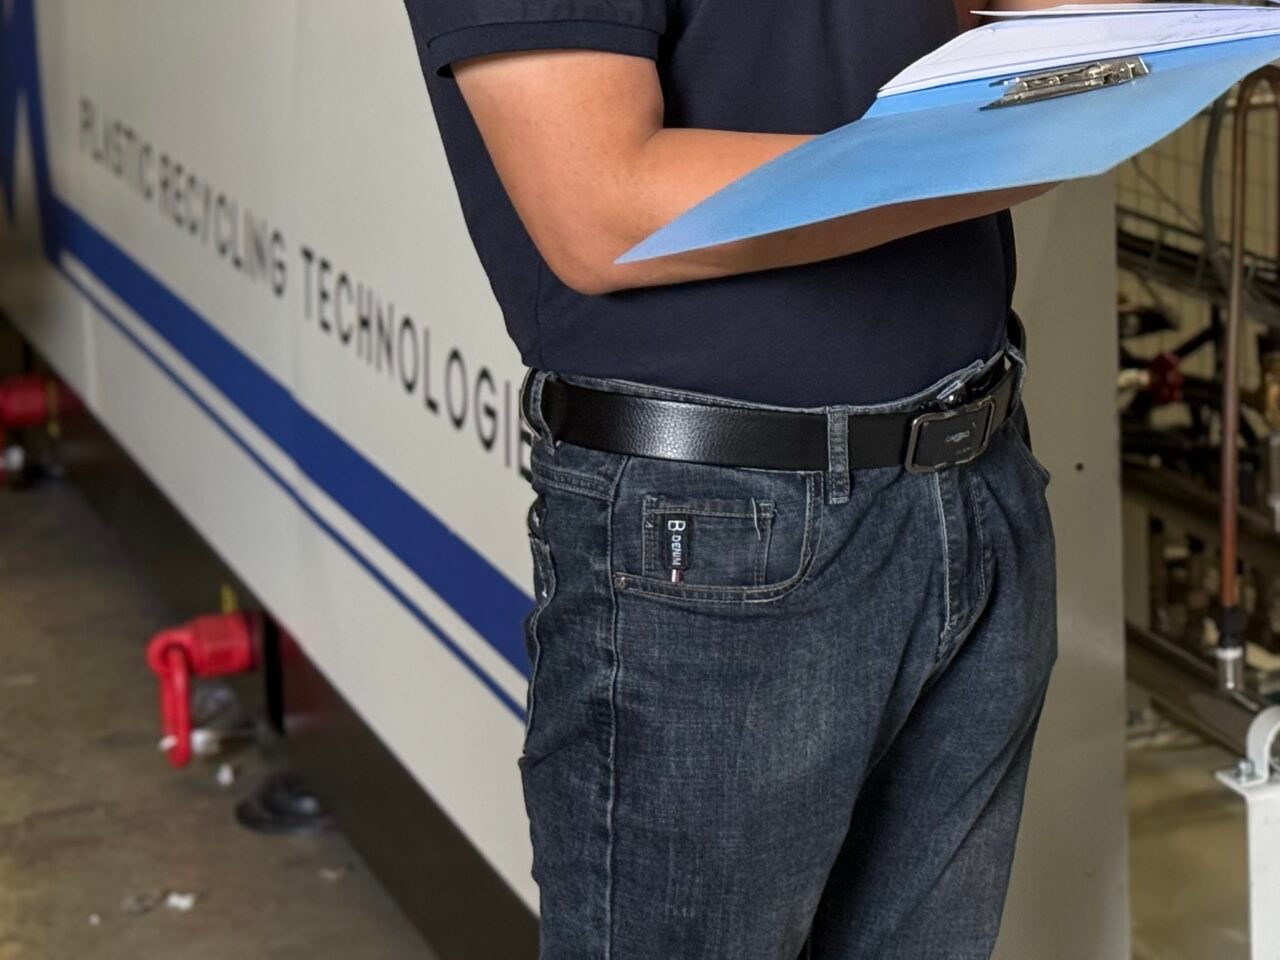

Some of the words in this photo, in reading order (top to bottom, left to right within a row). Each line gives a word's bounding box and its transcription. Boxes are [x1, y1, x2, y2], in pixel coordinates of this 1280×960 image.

[80, 97, 153, 202] PLASTIC
[159, 152, 288, 298] RECYCLING
[668, 520, 686, 531] B
